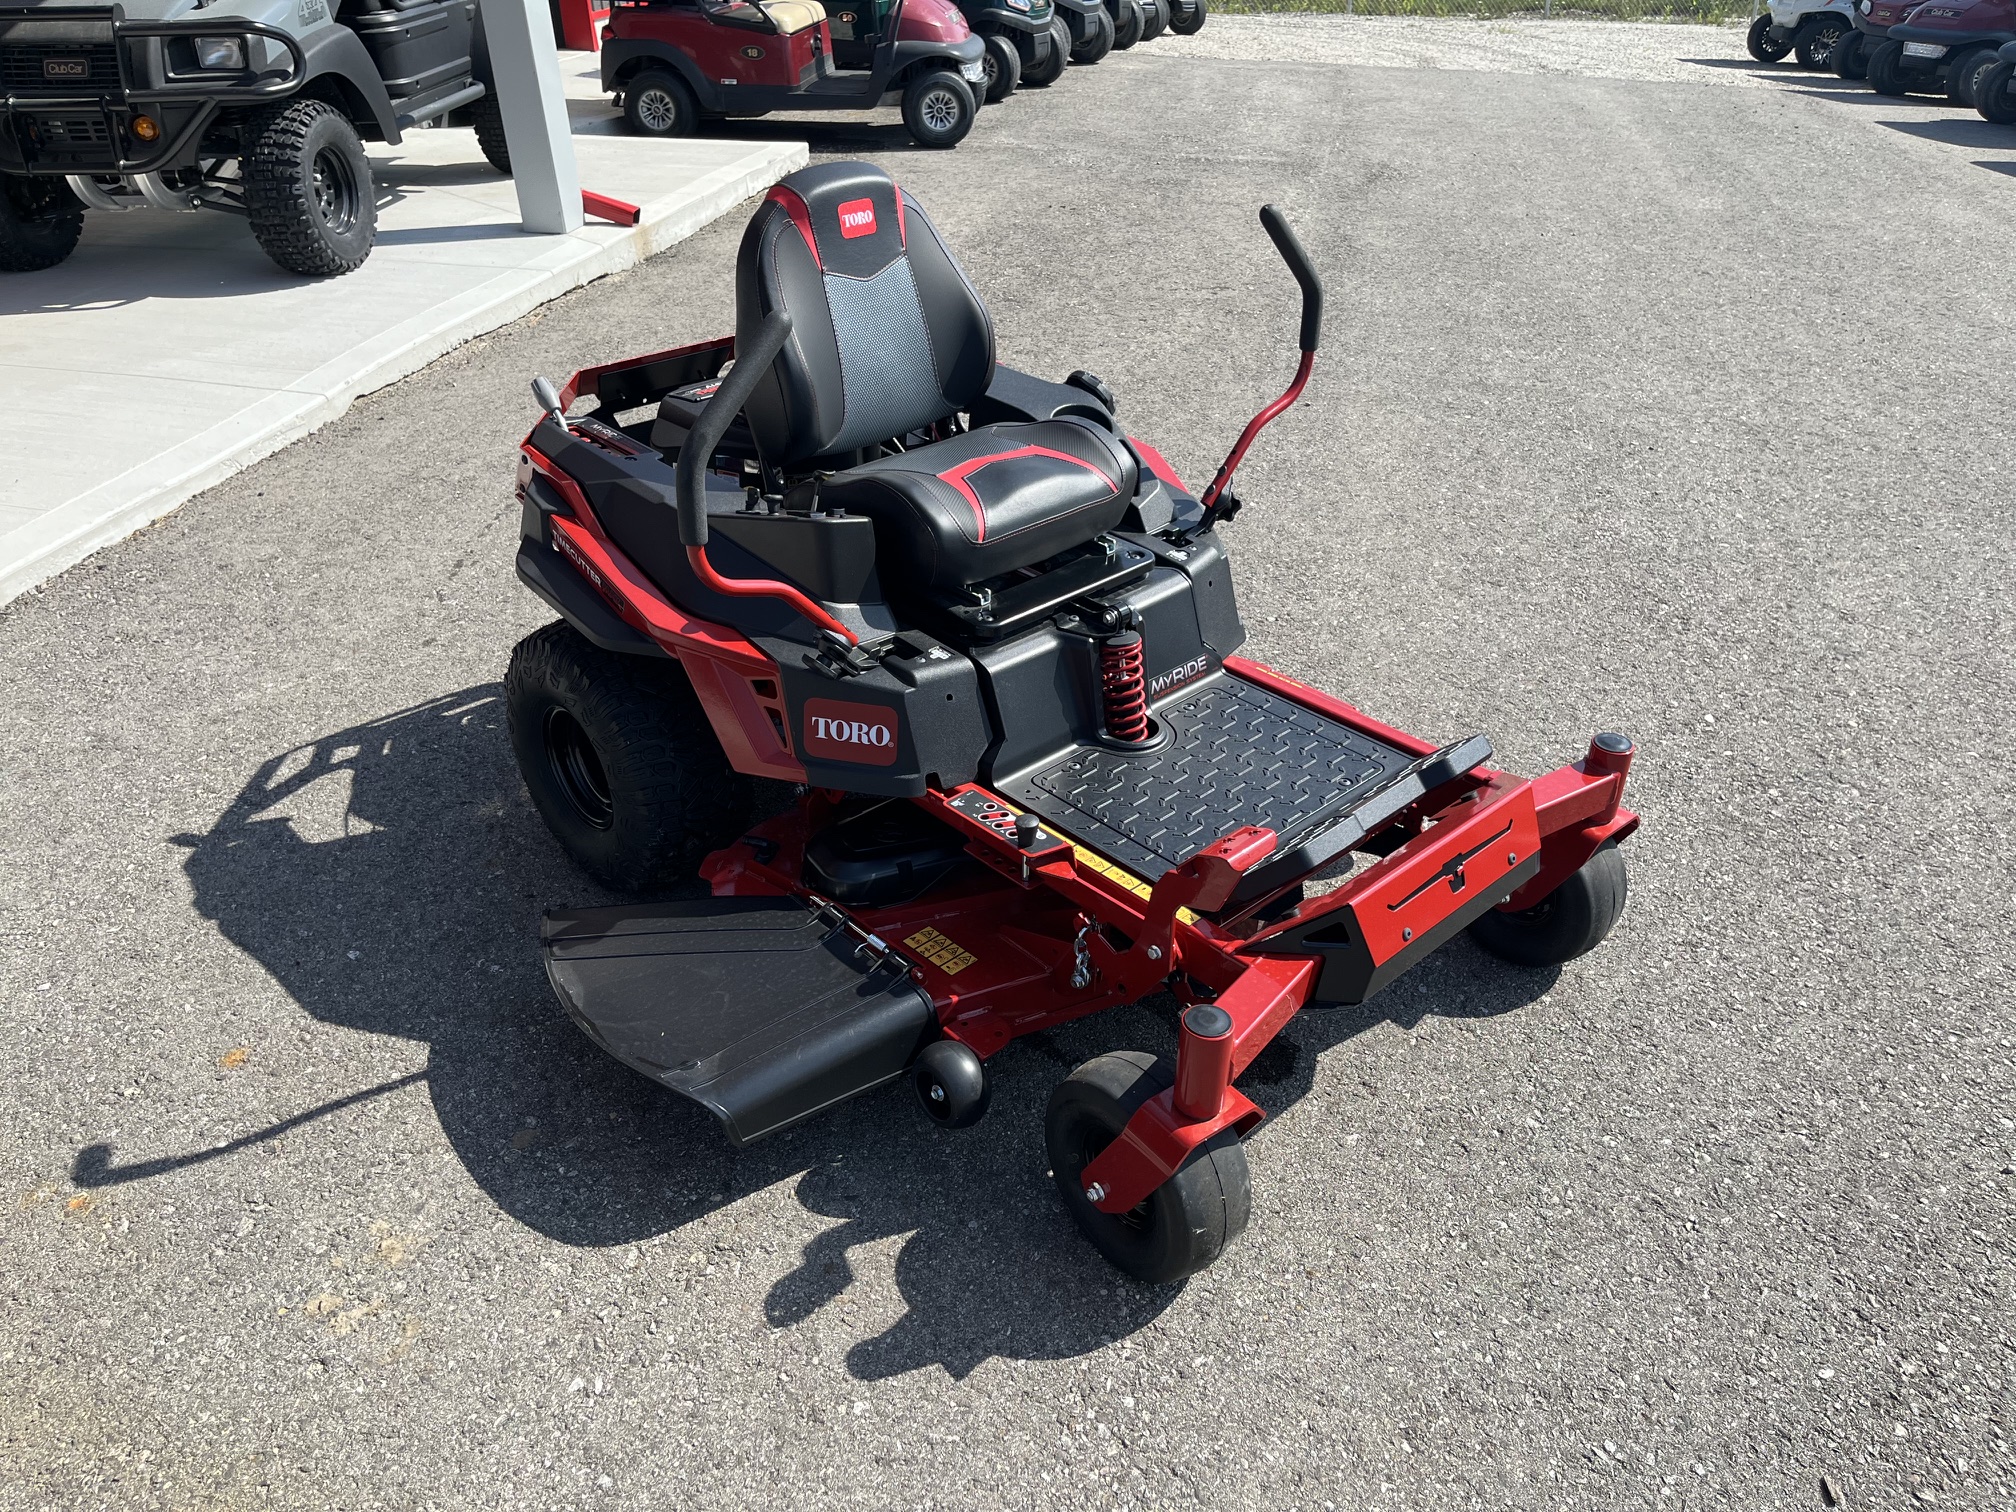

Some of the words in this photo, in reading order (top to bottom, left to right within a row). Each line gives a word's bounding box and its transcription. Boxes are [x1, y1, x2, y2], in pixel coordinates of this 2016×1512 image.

[747, 48, 758, 57] 18
[49, 63, 67, 74] Club
[68, 63, 83, 74] Car
[841, 209, 873, 228] TORO
[552, 529, 602, 588] TIMECUTTER
